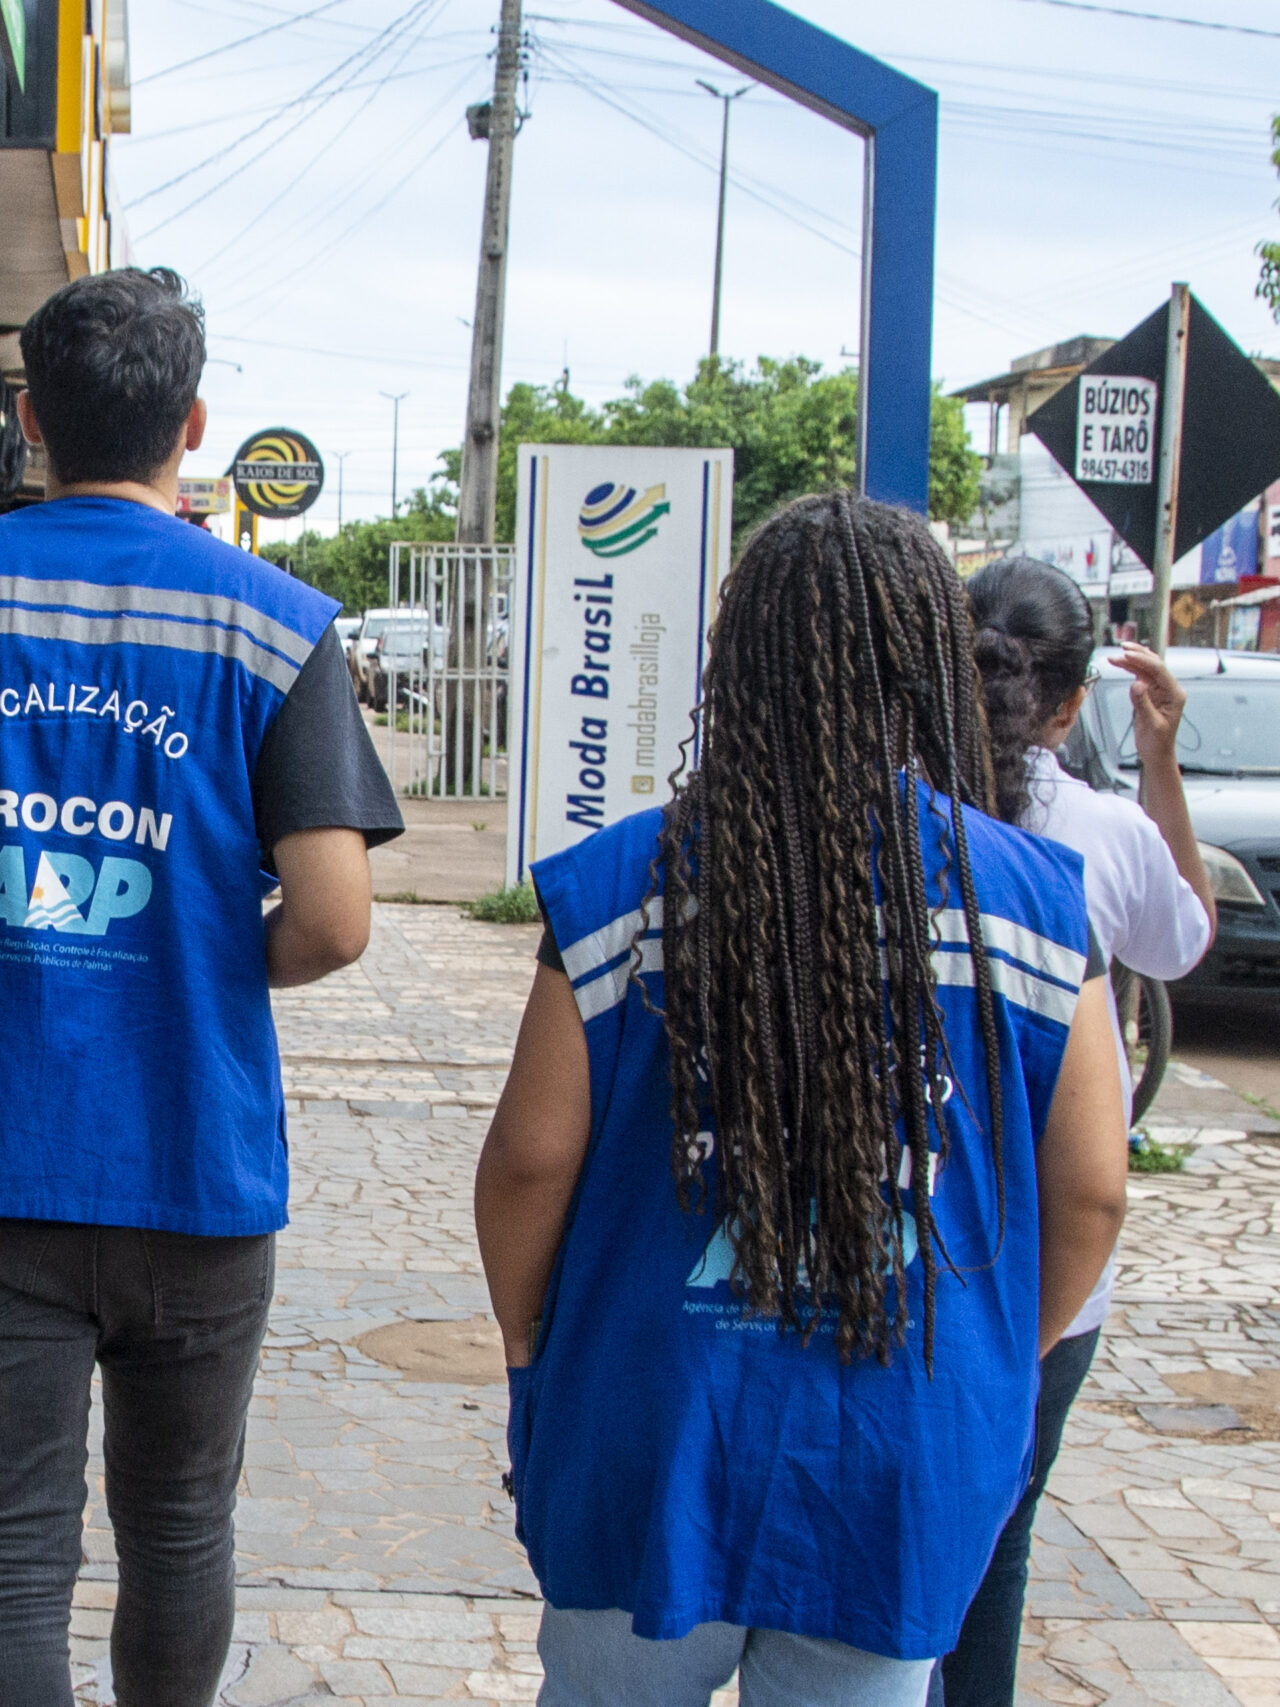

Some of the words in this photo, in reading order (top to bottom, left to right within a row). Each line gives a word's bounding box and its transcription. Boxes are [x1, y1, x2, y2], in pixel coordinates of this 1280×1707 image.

[1085, 380, 1151, 415] BÚZIOS
[1083, 424, 1093, 451] E
[1101, 419, 1148, 453] TARÔ
[236, 465, 275, 479] RAIOS
[277, 466, 292, 480] DE
[296, 466, 319, 480] SOL
[627, 613, 667, 768] modabrasilloja
[566, 716, 609, 831] Moda
[33, 954, 71, 967] Públicos
[71, 960, 82, 969] de
[83, 960, 113, 972] Palmas
[53, 943, 91, 956] Controle
[96, 947, 150, 963] Fiscalização
